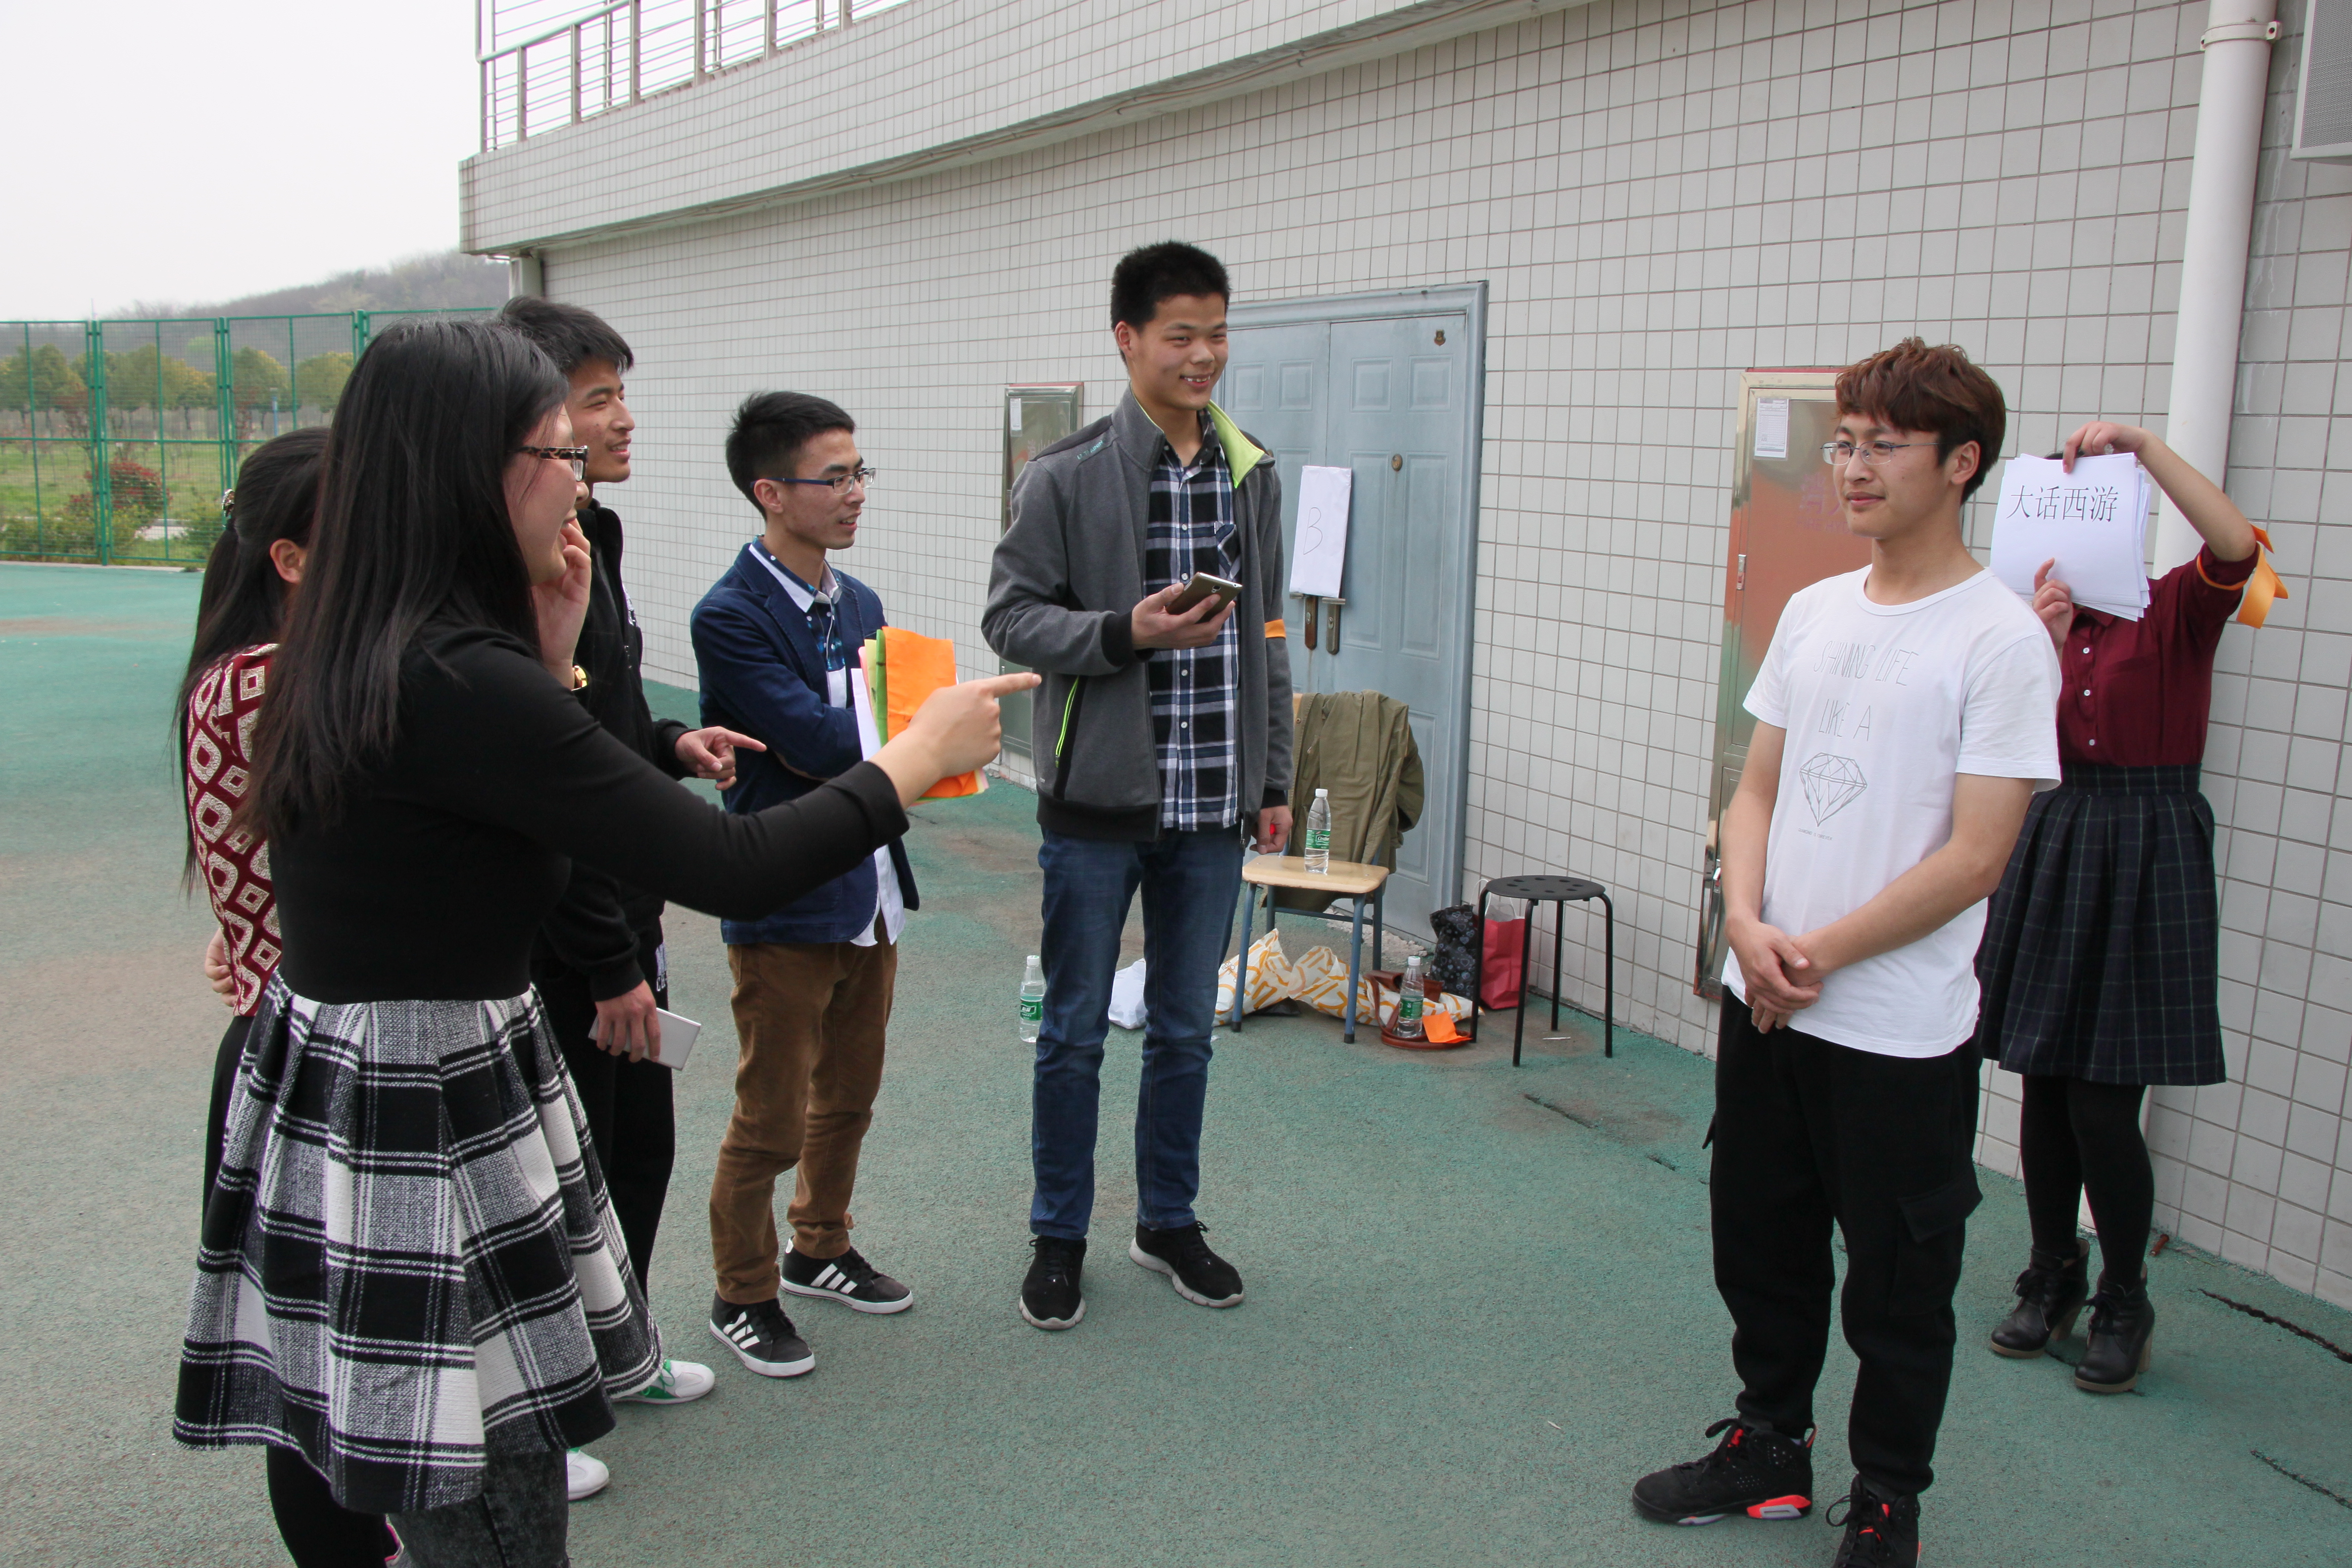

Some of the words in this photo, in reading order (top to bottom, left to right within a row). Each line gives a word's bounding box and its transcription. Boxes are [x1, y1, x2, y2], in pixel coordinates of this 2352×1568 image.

[2006, 485, 2119, 523] 大话西游
[1303, 507, 1323, 555] B
[1813, 640, 1876, 679] SHINING
[1875, 648, 1919, 686] LIFE
[1818, 698, 1850, 737] LIKE
[1853, 705, 1871, 741] A
